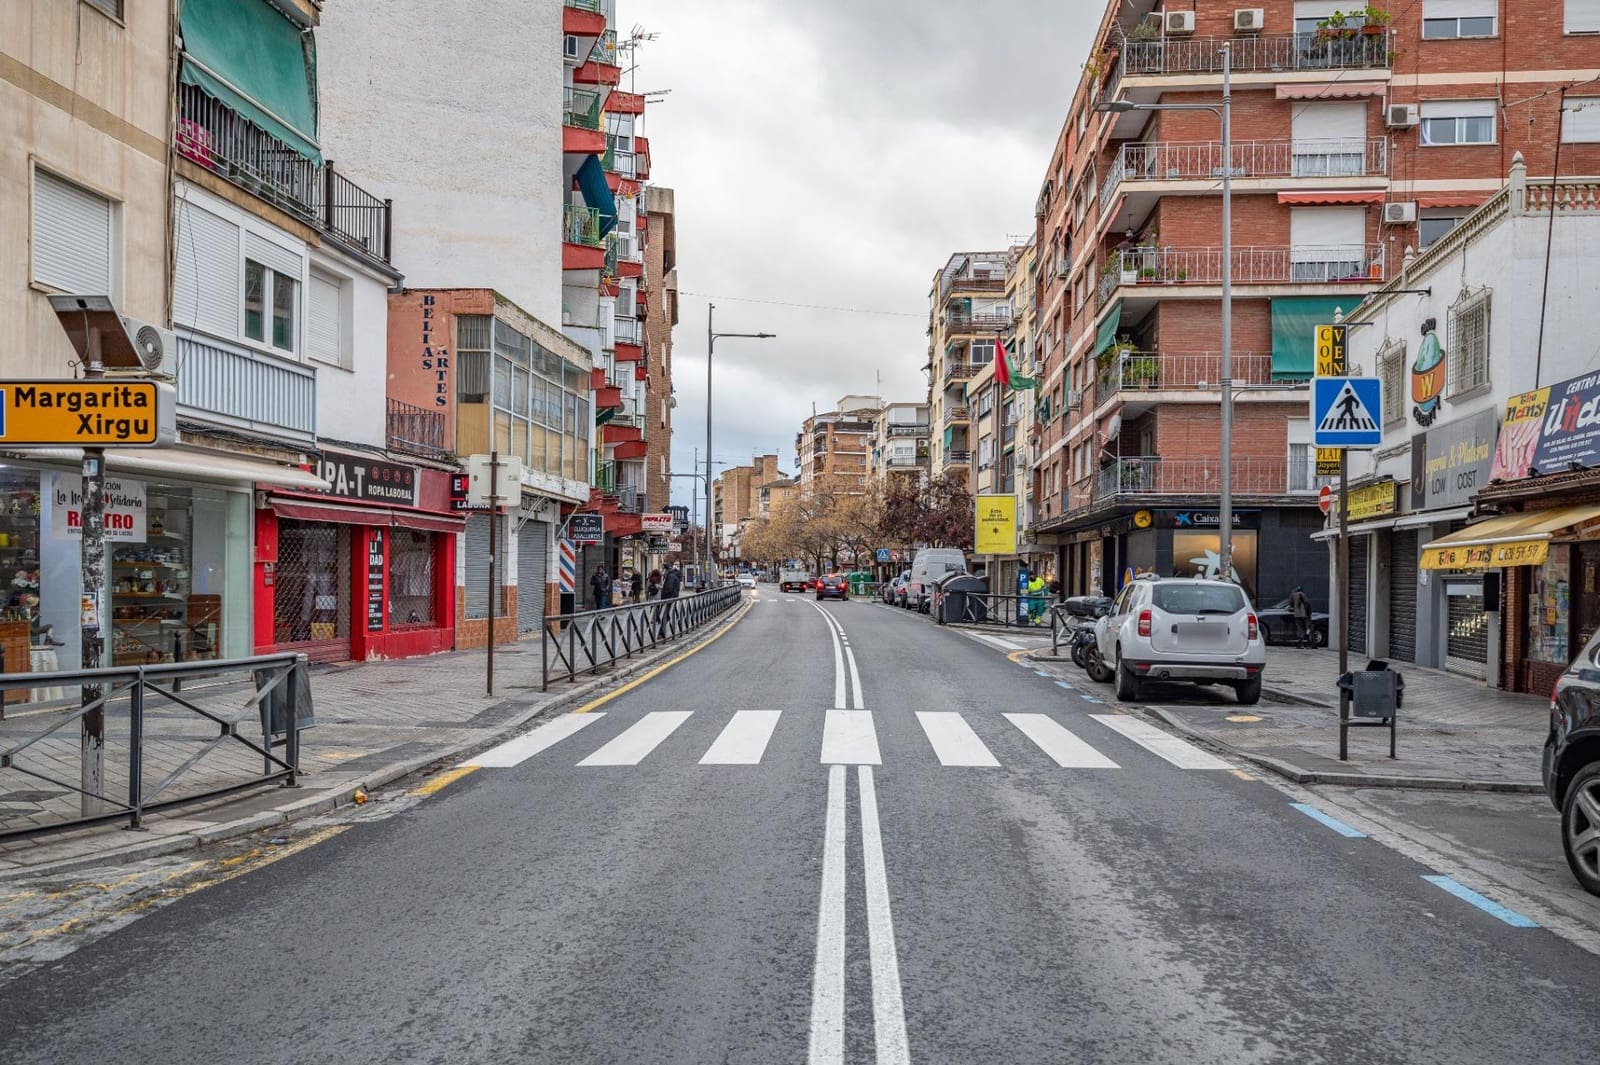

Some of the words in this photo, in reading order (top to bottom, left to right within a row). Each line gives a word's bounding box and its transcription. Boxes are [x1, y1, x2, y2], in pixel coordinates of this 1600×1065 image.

[1320, 328, 1331, 376] COM
[1332, 329, 1345, 376] VEN
[1422, 373, 1435, 399] W
[1566, 375, 1597, 395] CENTRO
[15, 387, 148, 412] Margarita
[76, 414, 149, 438] Xirgu
[1317, 448, 1341, 460] PLAT
[368, 484, 385, 496] ROPA
[385, 486, 413, 499] LABORAL
[1431, 478, 1446, 494] LOW
[1457, 470, 1477, 490] COST
[57, 489, 66, 505] La
[68, 511, 133, 530] RTRO
[1193, 513, 1240, 523] Caixank
[369, 554, 384, 565] DAD
[1020, 573, 1026, 582] P
